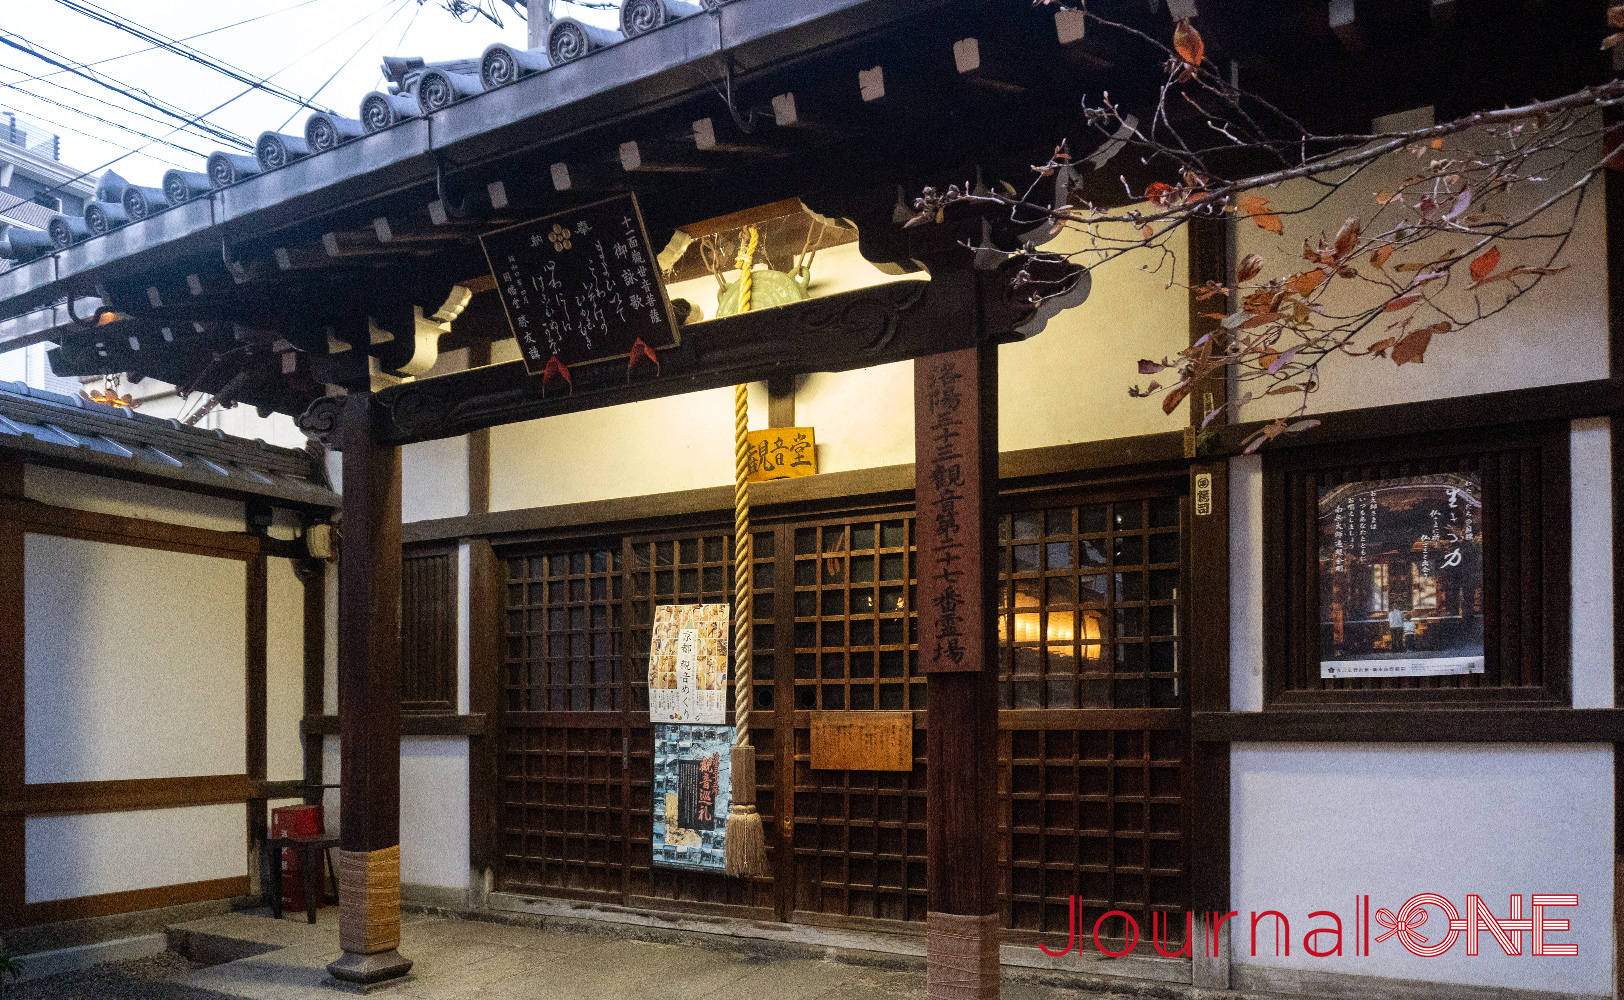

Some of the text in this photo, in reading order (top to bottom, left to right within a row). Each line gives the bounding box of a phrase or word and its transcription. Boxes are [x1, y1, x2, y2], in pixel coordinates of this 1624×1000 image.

[613, 243, 645, 311] 御詠歌
[747, 433, 812, 476] 観音堂
[698, 756, 714, 821] 観音巡礼
